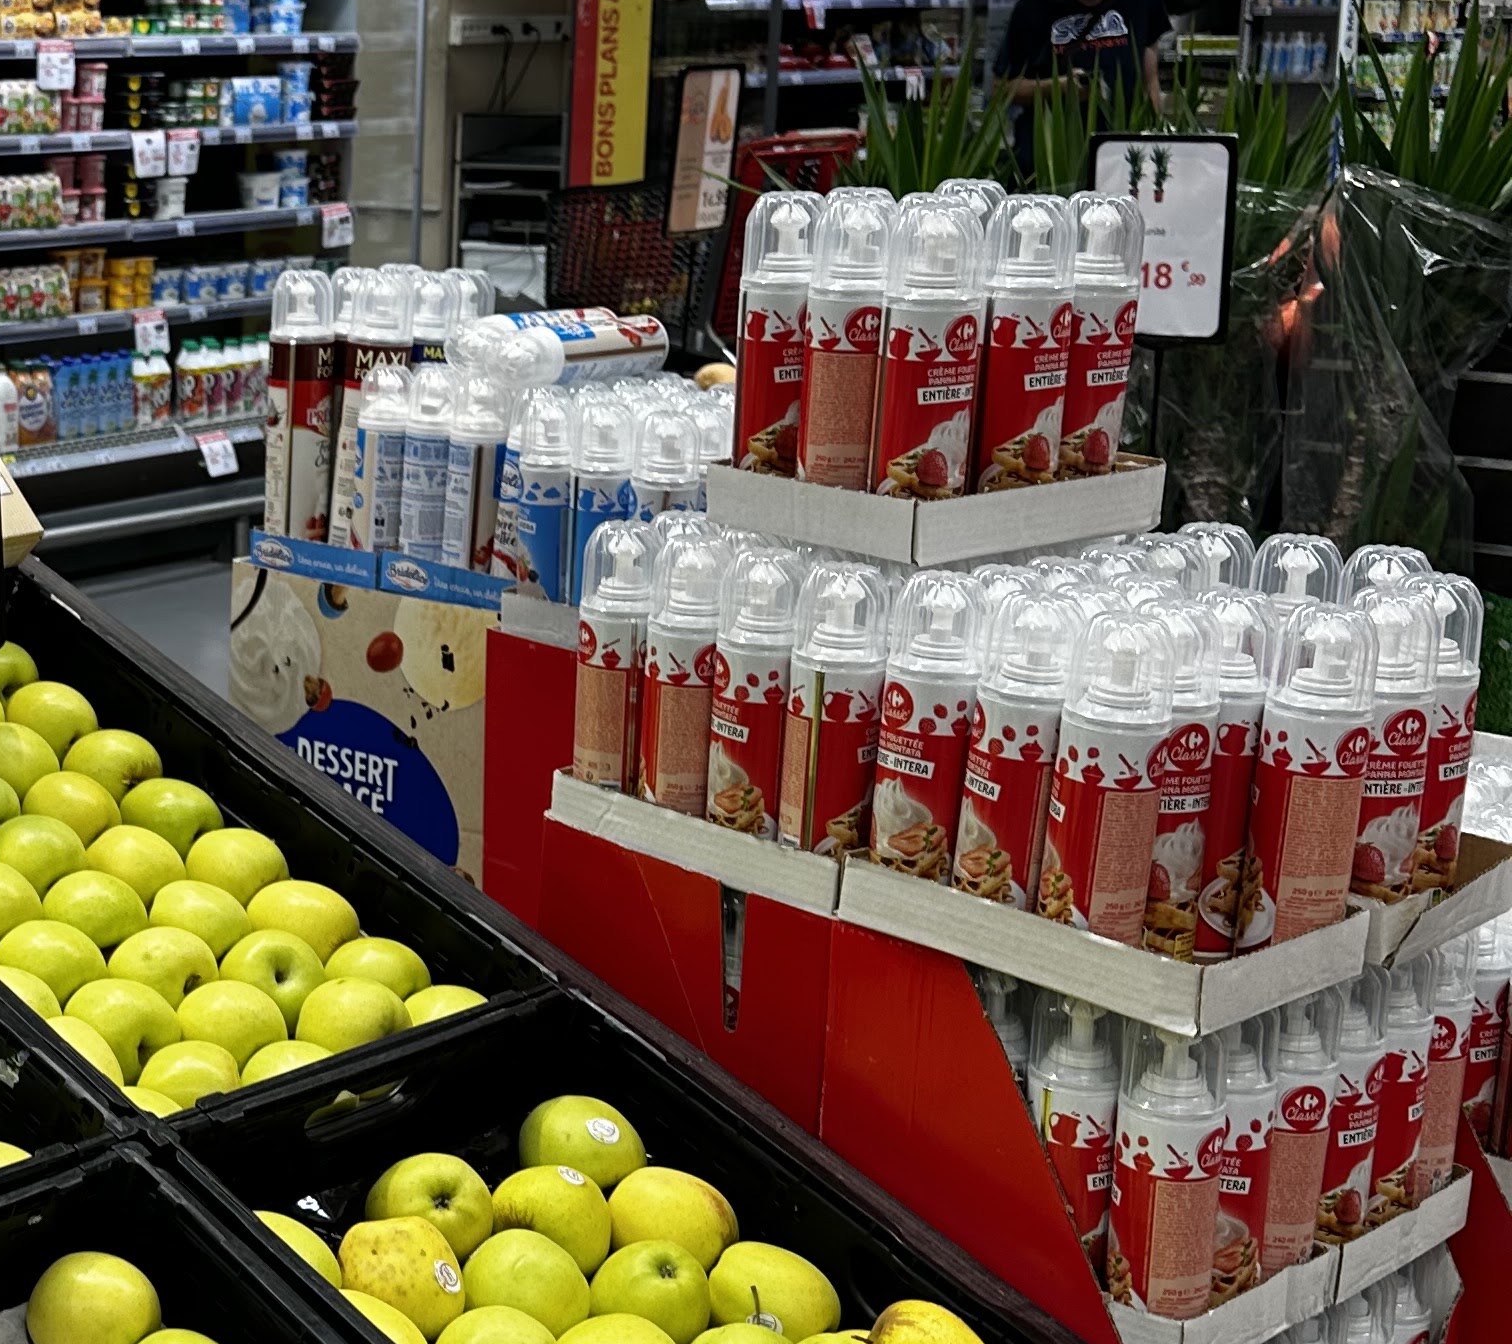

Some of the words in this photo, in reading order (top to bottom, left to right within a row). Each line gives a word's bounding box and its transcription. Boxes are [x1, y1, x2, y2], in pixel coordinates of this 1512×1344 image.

[599, 9, 620, 98] PLANS
[595, 103, 617, 178] BONS
[1140, 261, 1173, 290] 18
[355, 348, 407, 370] MAXI
[297, 736, 399, 802] DESSERT
